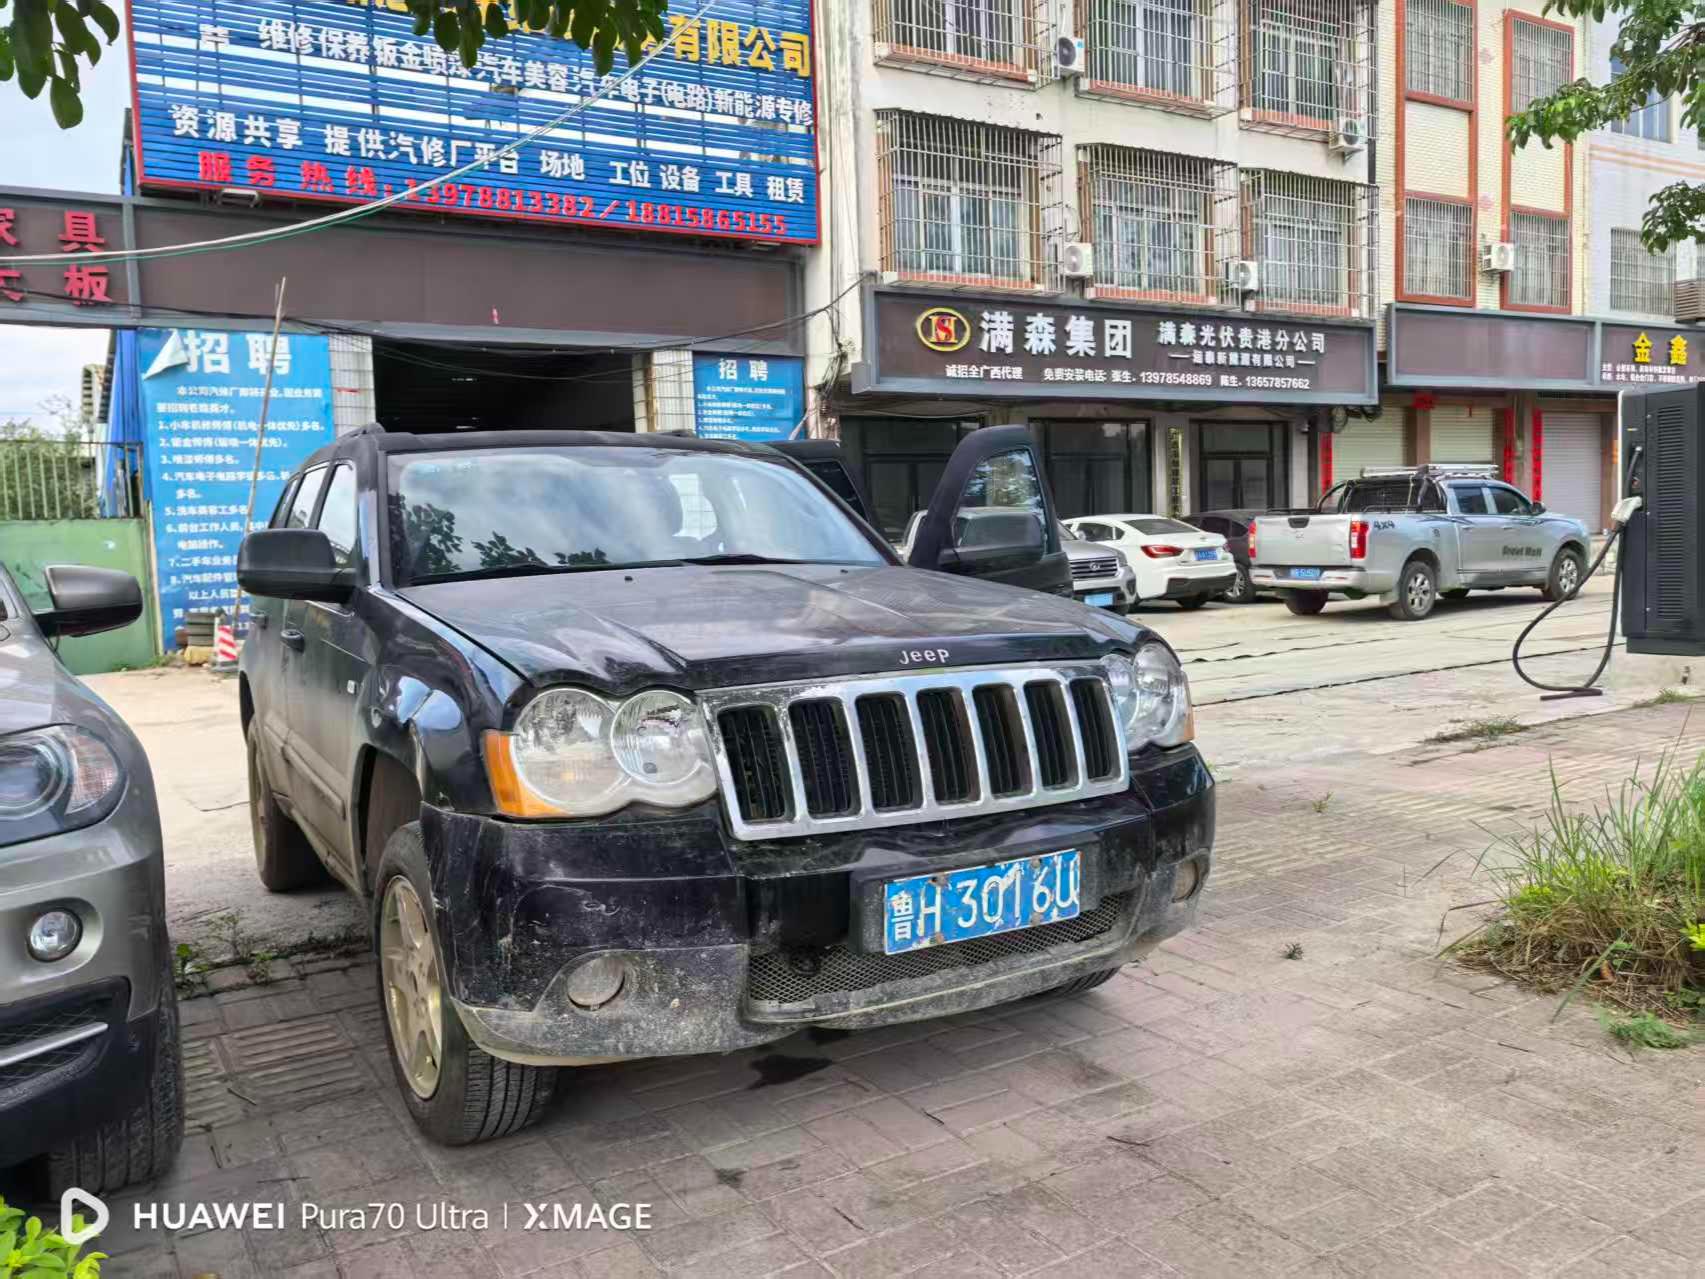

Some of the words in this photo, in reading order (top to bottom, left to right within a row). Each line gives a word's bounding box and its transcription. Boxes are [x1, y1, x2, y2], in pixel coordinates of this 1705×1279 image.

[668, 15, 811, 77] 有限公司
[169, 104, 303, 149] 资源共享
[324, 124, 519, 174] 提供汽修厂平台
[539, 150, 585, 181] 场地
[608, 160, 651, 188] 工位
[659, 164, 700, 192] 设备
[715, 171, 753, 198] 工具
[766, 175, 804, 204] 租赁
[185, 330, 292, 375] 招聘
[978, 310, 1132, 359] 满森集团
[719, 358, 768, 381] 招聘
[945, 364, 1023, 381] 诚招全广西代理
[1140, 371, 1212, 386] 13978548869
[899, 648, 949, 665] Jeep
